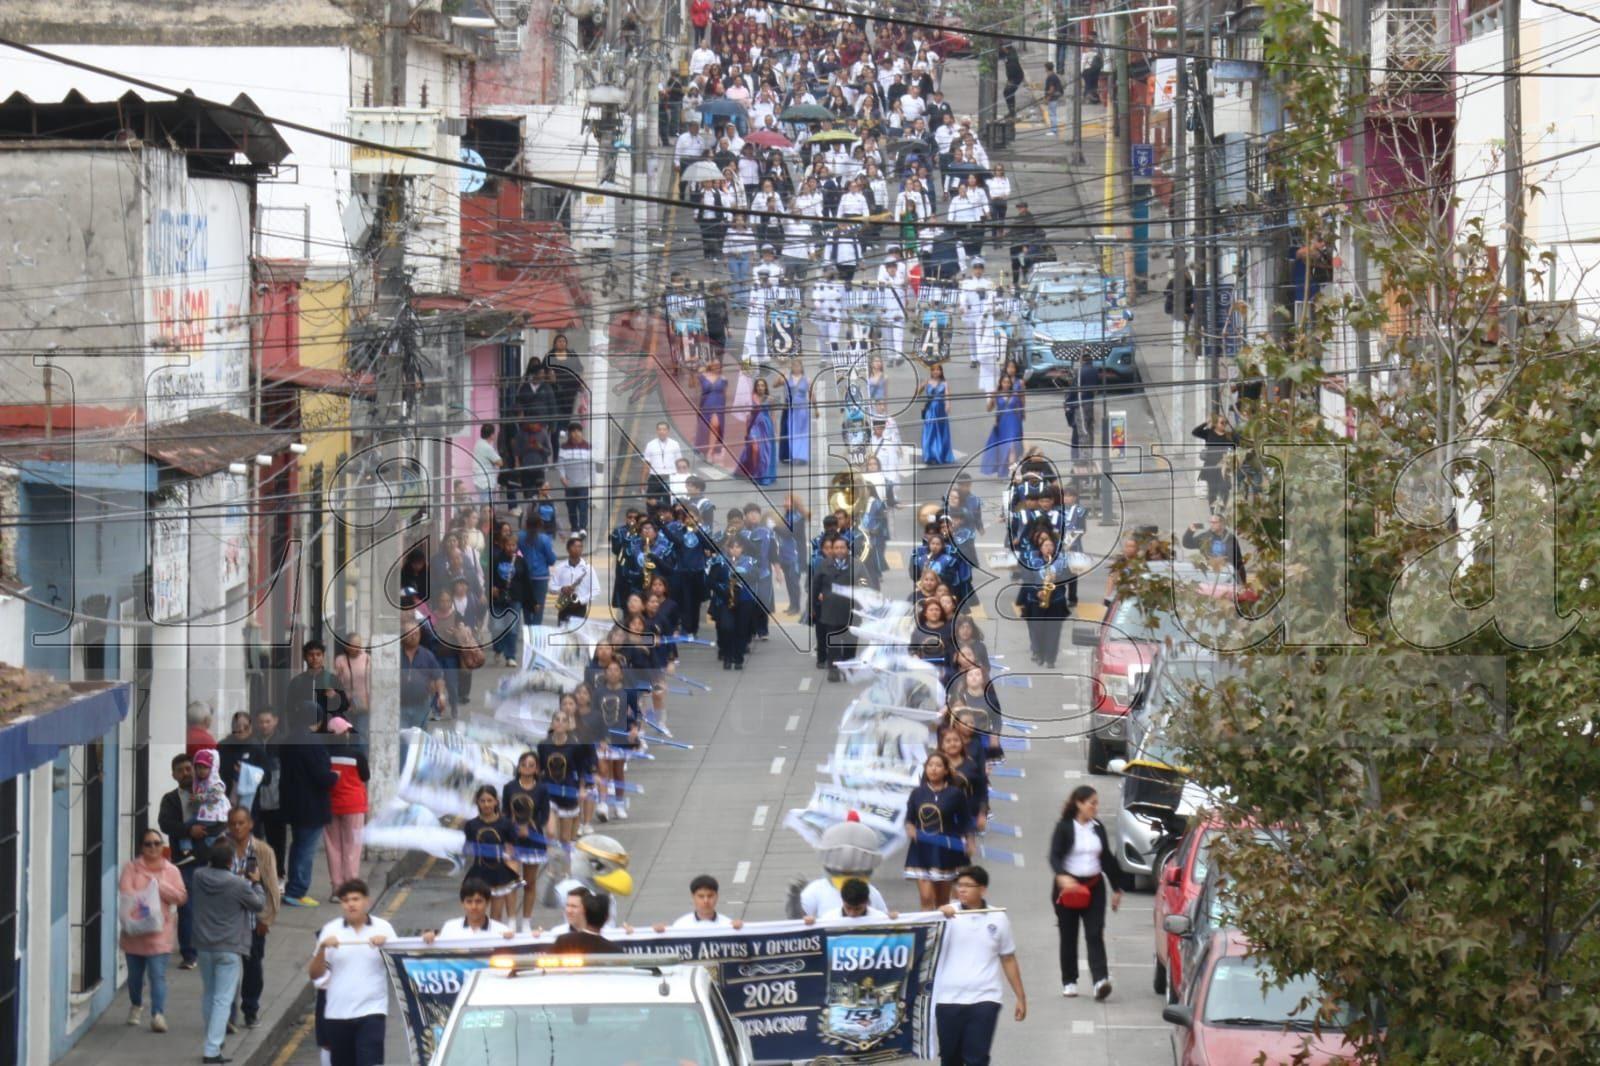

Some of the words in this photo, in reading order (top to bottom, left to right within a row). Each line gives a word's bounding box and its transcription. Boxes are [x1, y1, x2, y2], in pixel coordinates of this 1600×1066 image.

[698, 941, 748, 960] ARTES
[752, 941, 763, 956] Y
[766, 935, 821, 956] OFICIOS
[831, 945, 909, 971] ESBAO
[412, 969, 468, 994] ESB
[743, 981, 798, 1008] 2026
